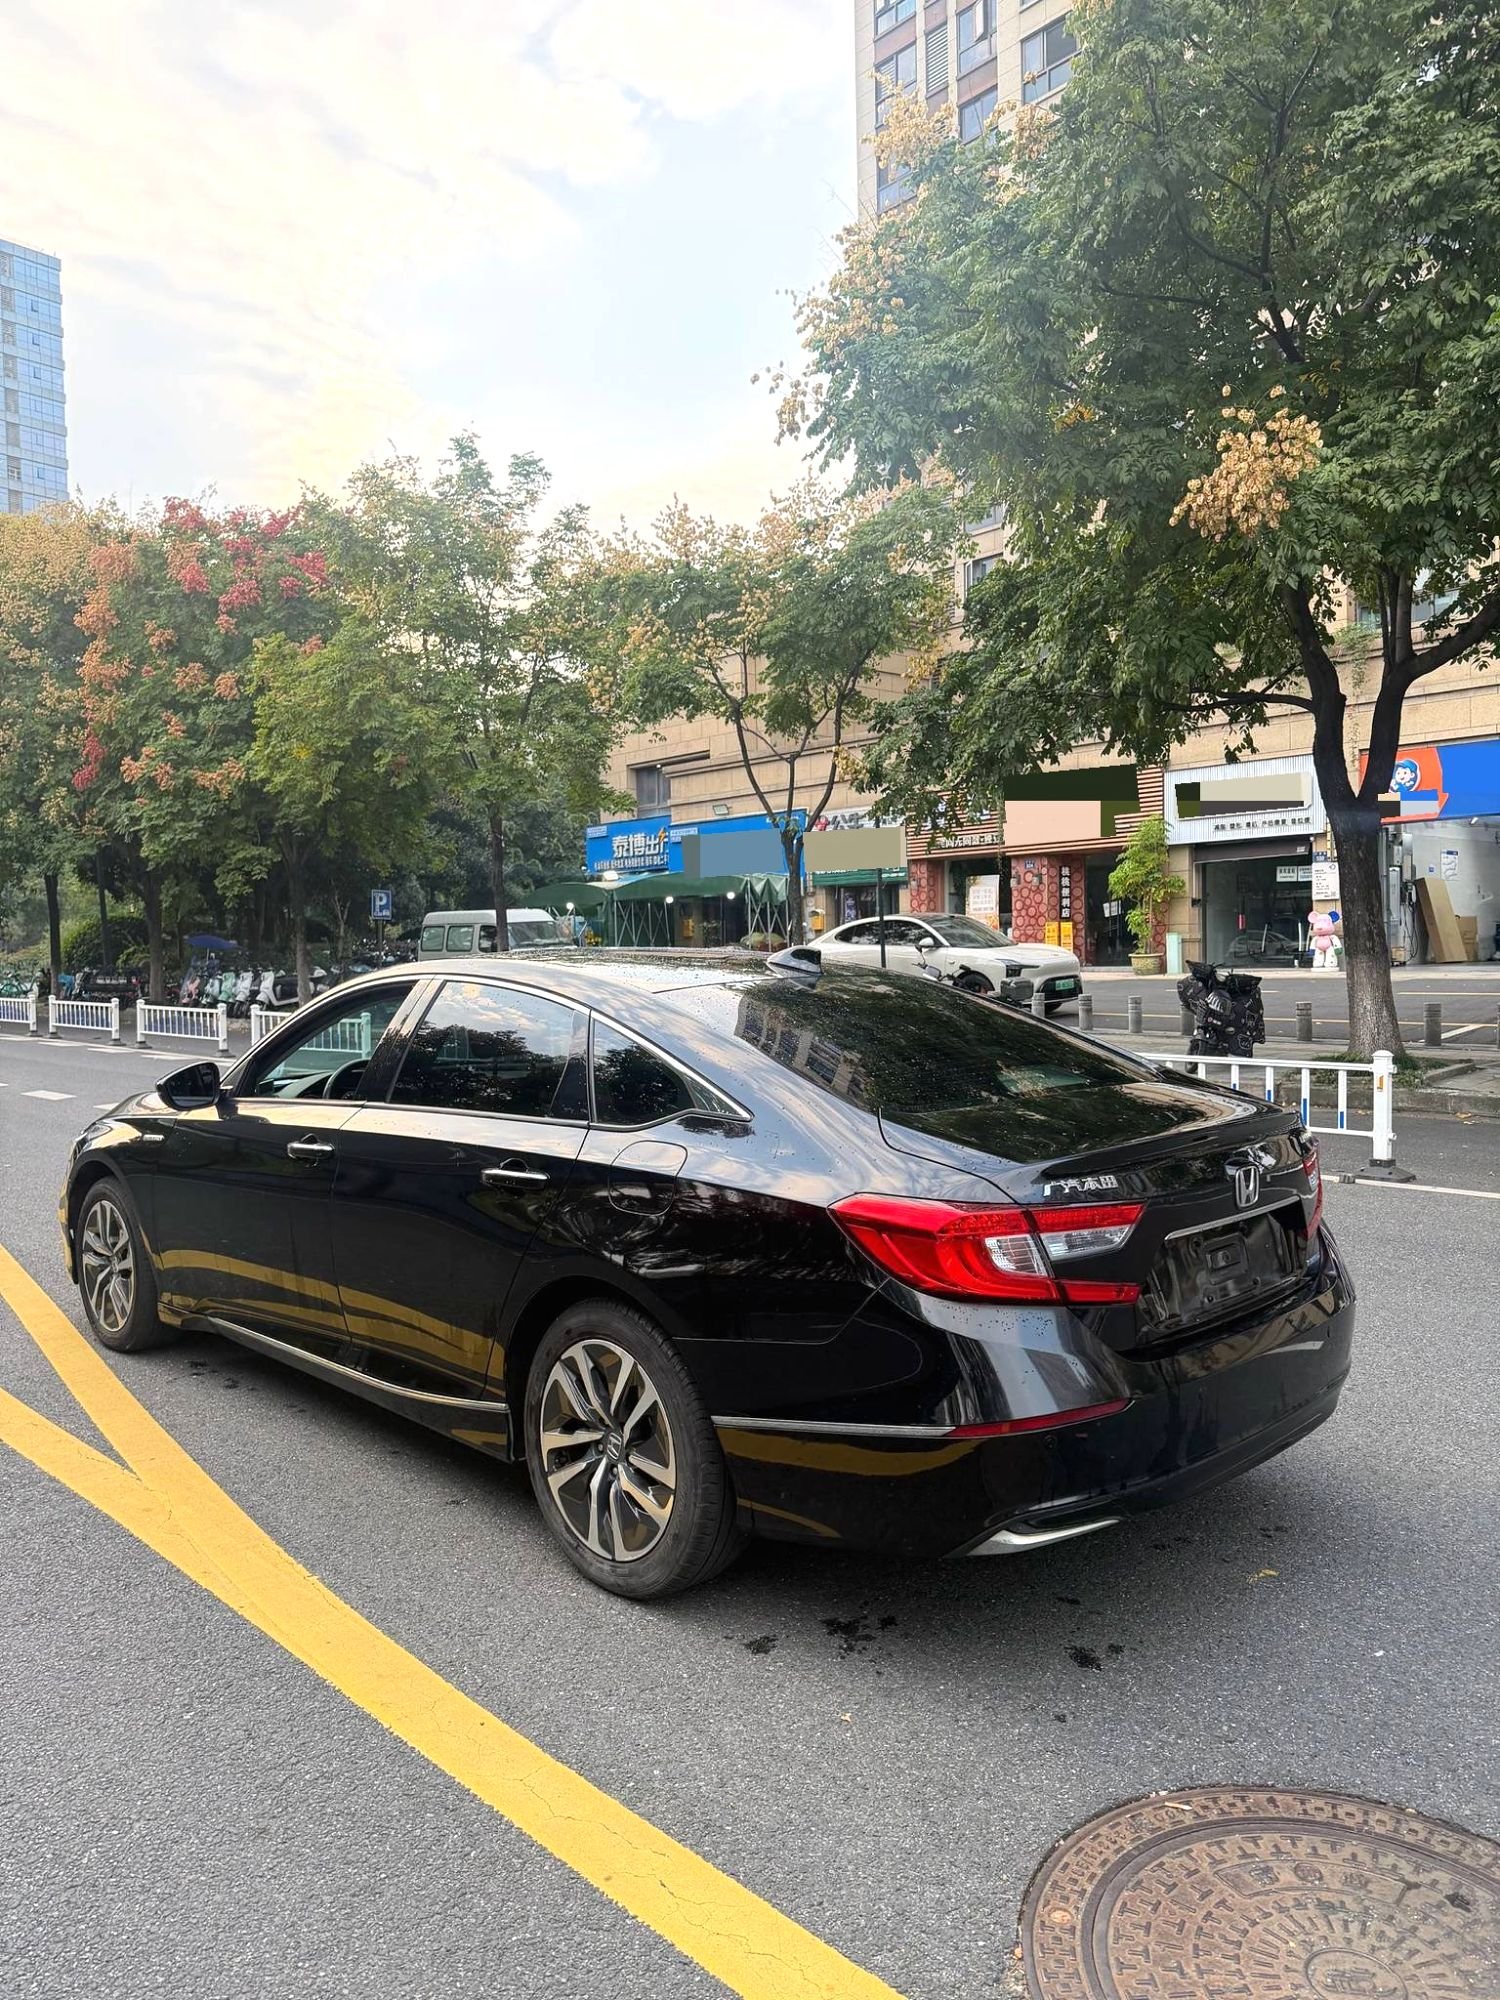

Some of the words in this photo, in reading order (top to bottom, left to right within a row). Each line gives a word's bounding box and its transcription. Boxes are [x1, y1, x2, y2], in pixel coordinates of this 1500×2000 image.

[374, 892, 388, 916] P
[1043, 1174, 1119, 1197] 广汽本田
